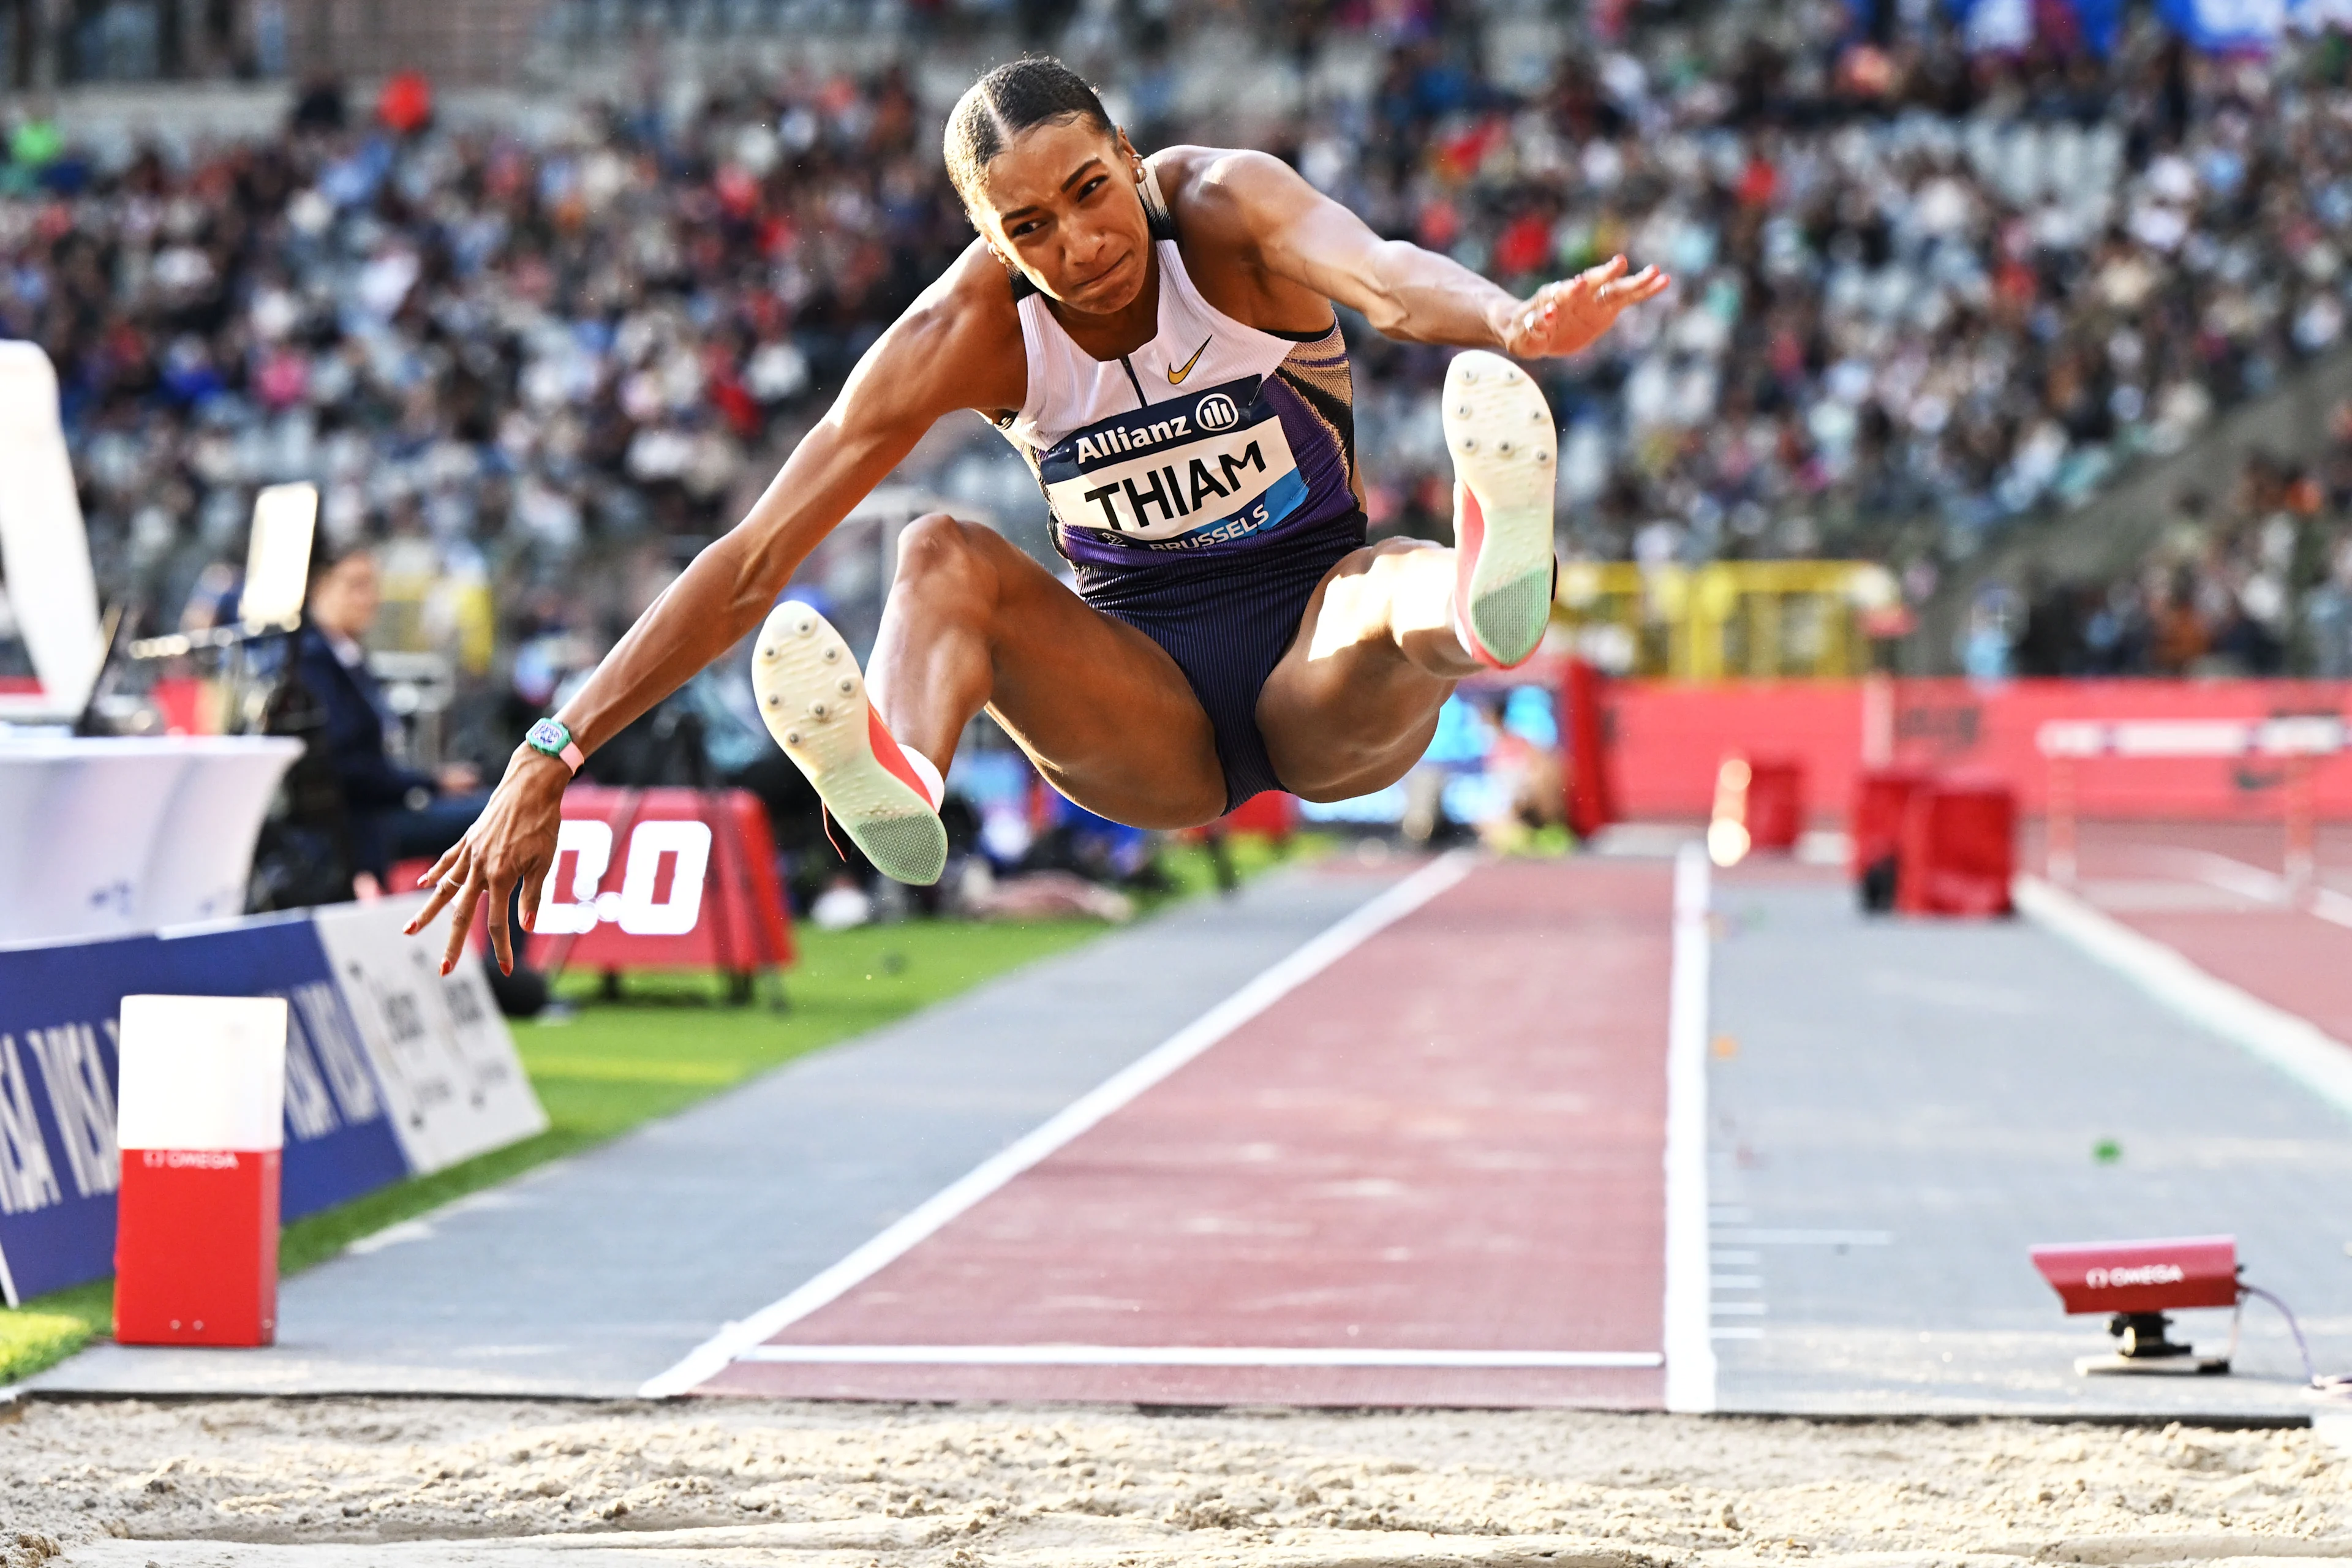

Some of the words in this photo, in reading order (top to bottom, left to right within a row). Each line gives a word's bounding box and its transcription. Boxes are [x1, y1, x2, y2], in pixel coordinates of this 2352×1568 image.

[1076, 415, 1192, 464] Allianz
[1084, 440, 1267, 531] THIAM
[2109, 1263, 2185, 1287] OMEGA
